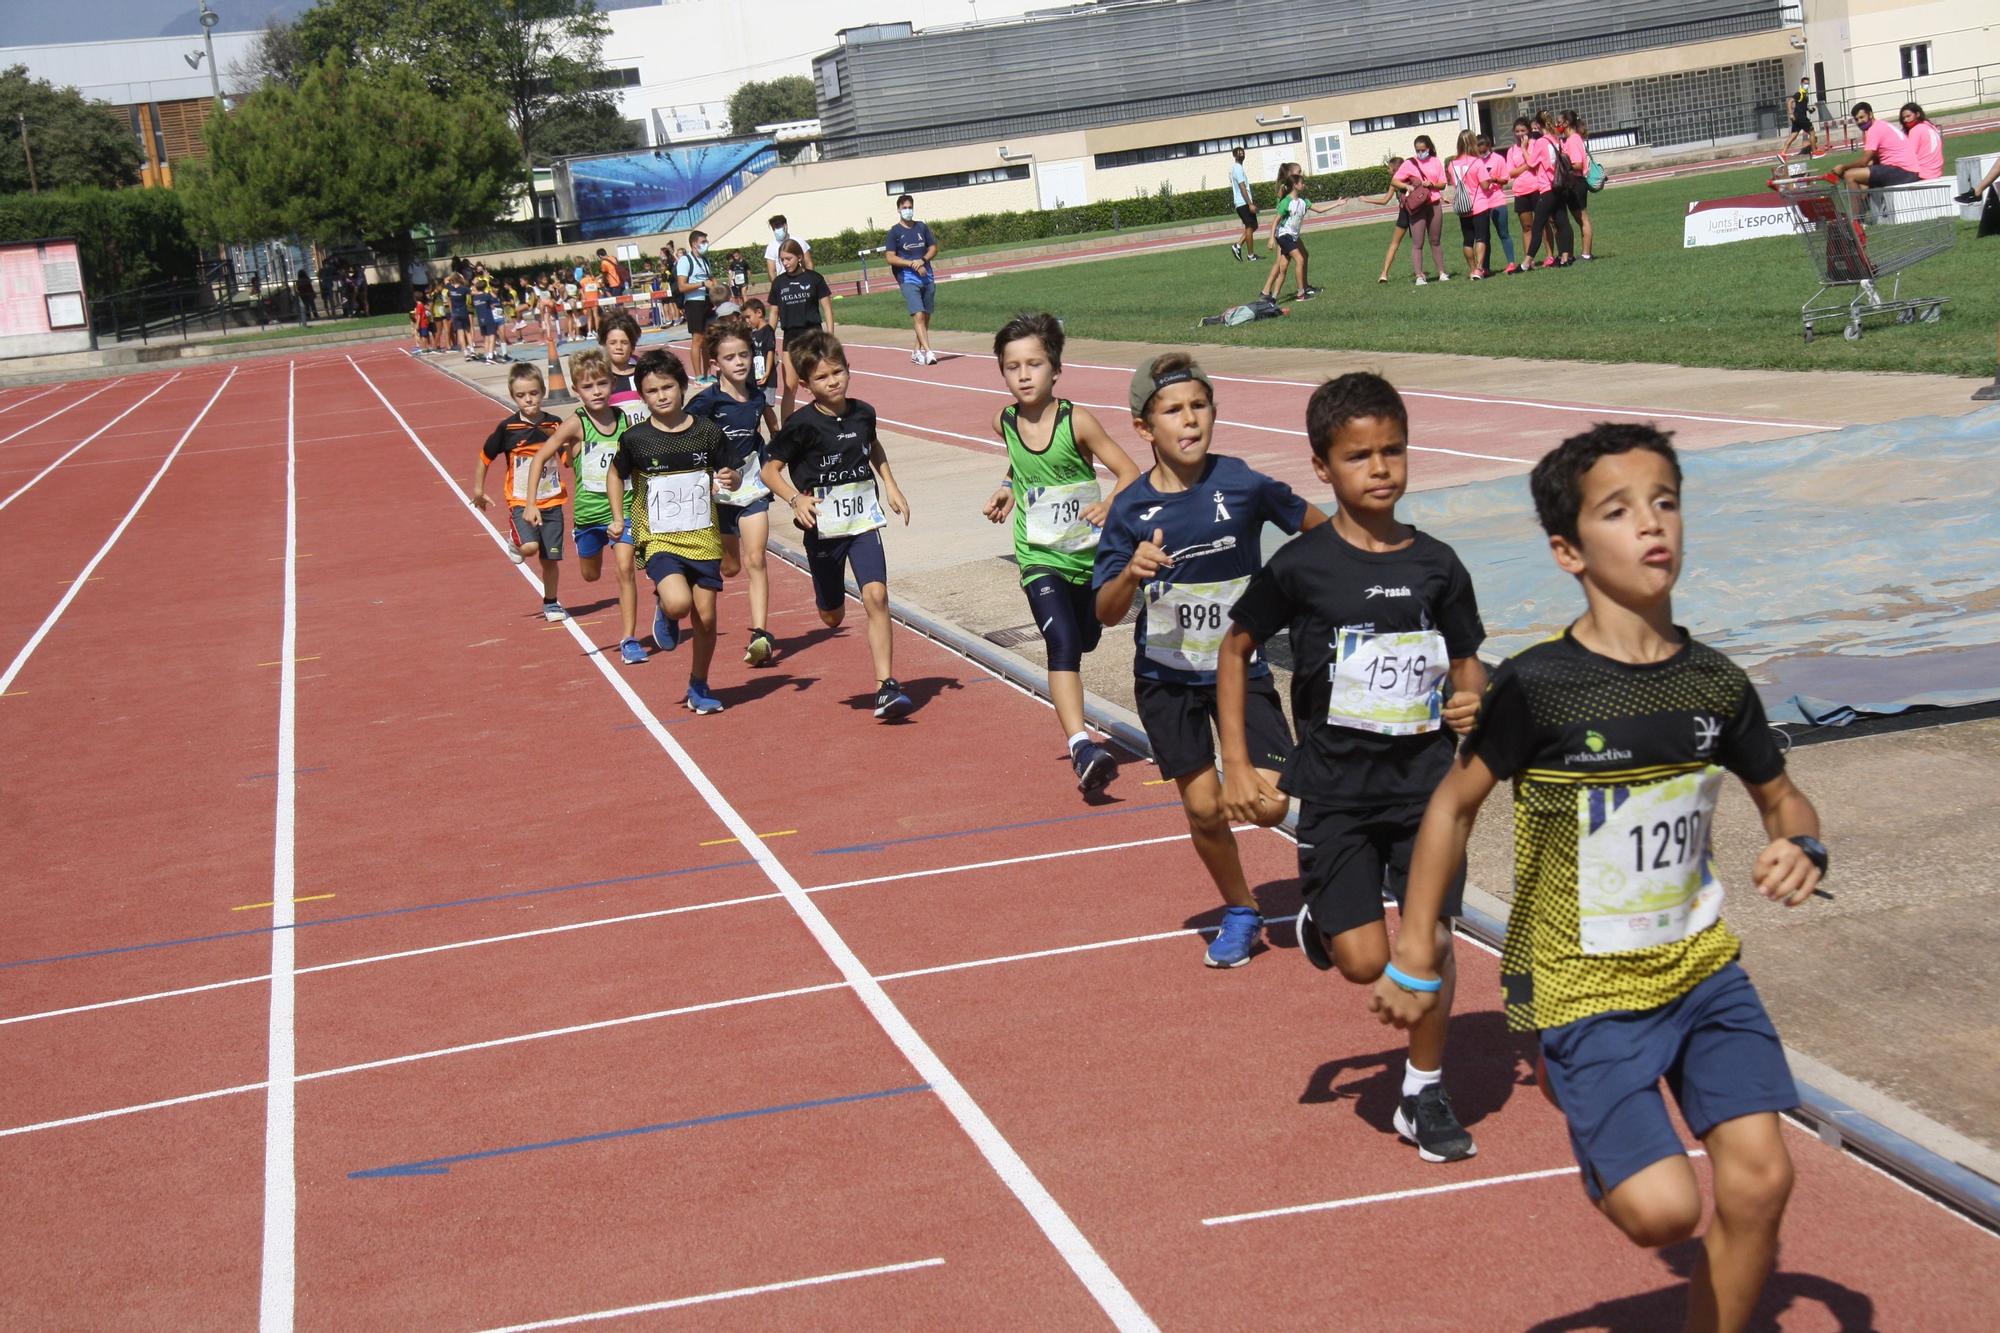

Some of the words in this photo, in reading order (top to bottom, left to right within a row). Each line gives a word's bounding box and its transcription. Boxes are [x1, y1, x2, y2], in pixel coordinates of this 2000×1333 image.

[1708, 217, 1732, 231] Junts
[1738, 212, 1791, 229] L'ESPORT
[650, 484, 709, 521] 1343
[833, 495, 864, 518] 1518
[1051, 499, 1080, 525] 739
[1178, 602, 1222, 631] 898
[1364, 655, 1427, 696] 1519
